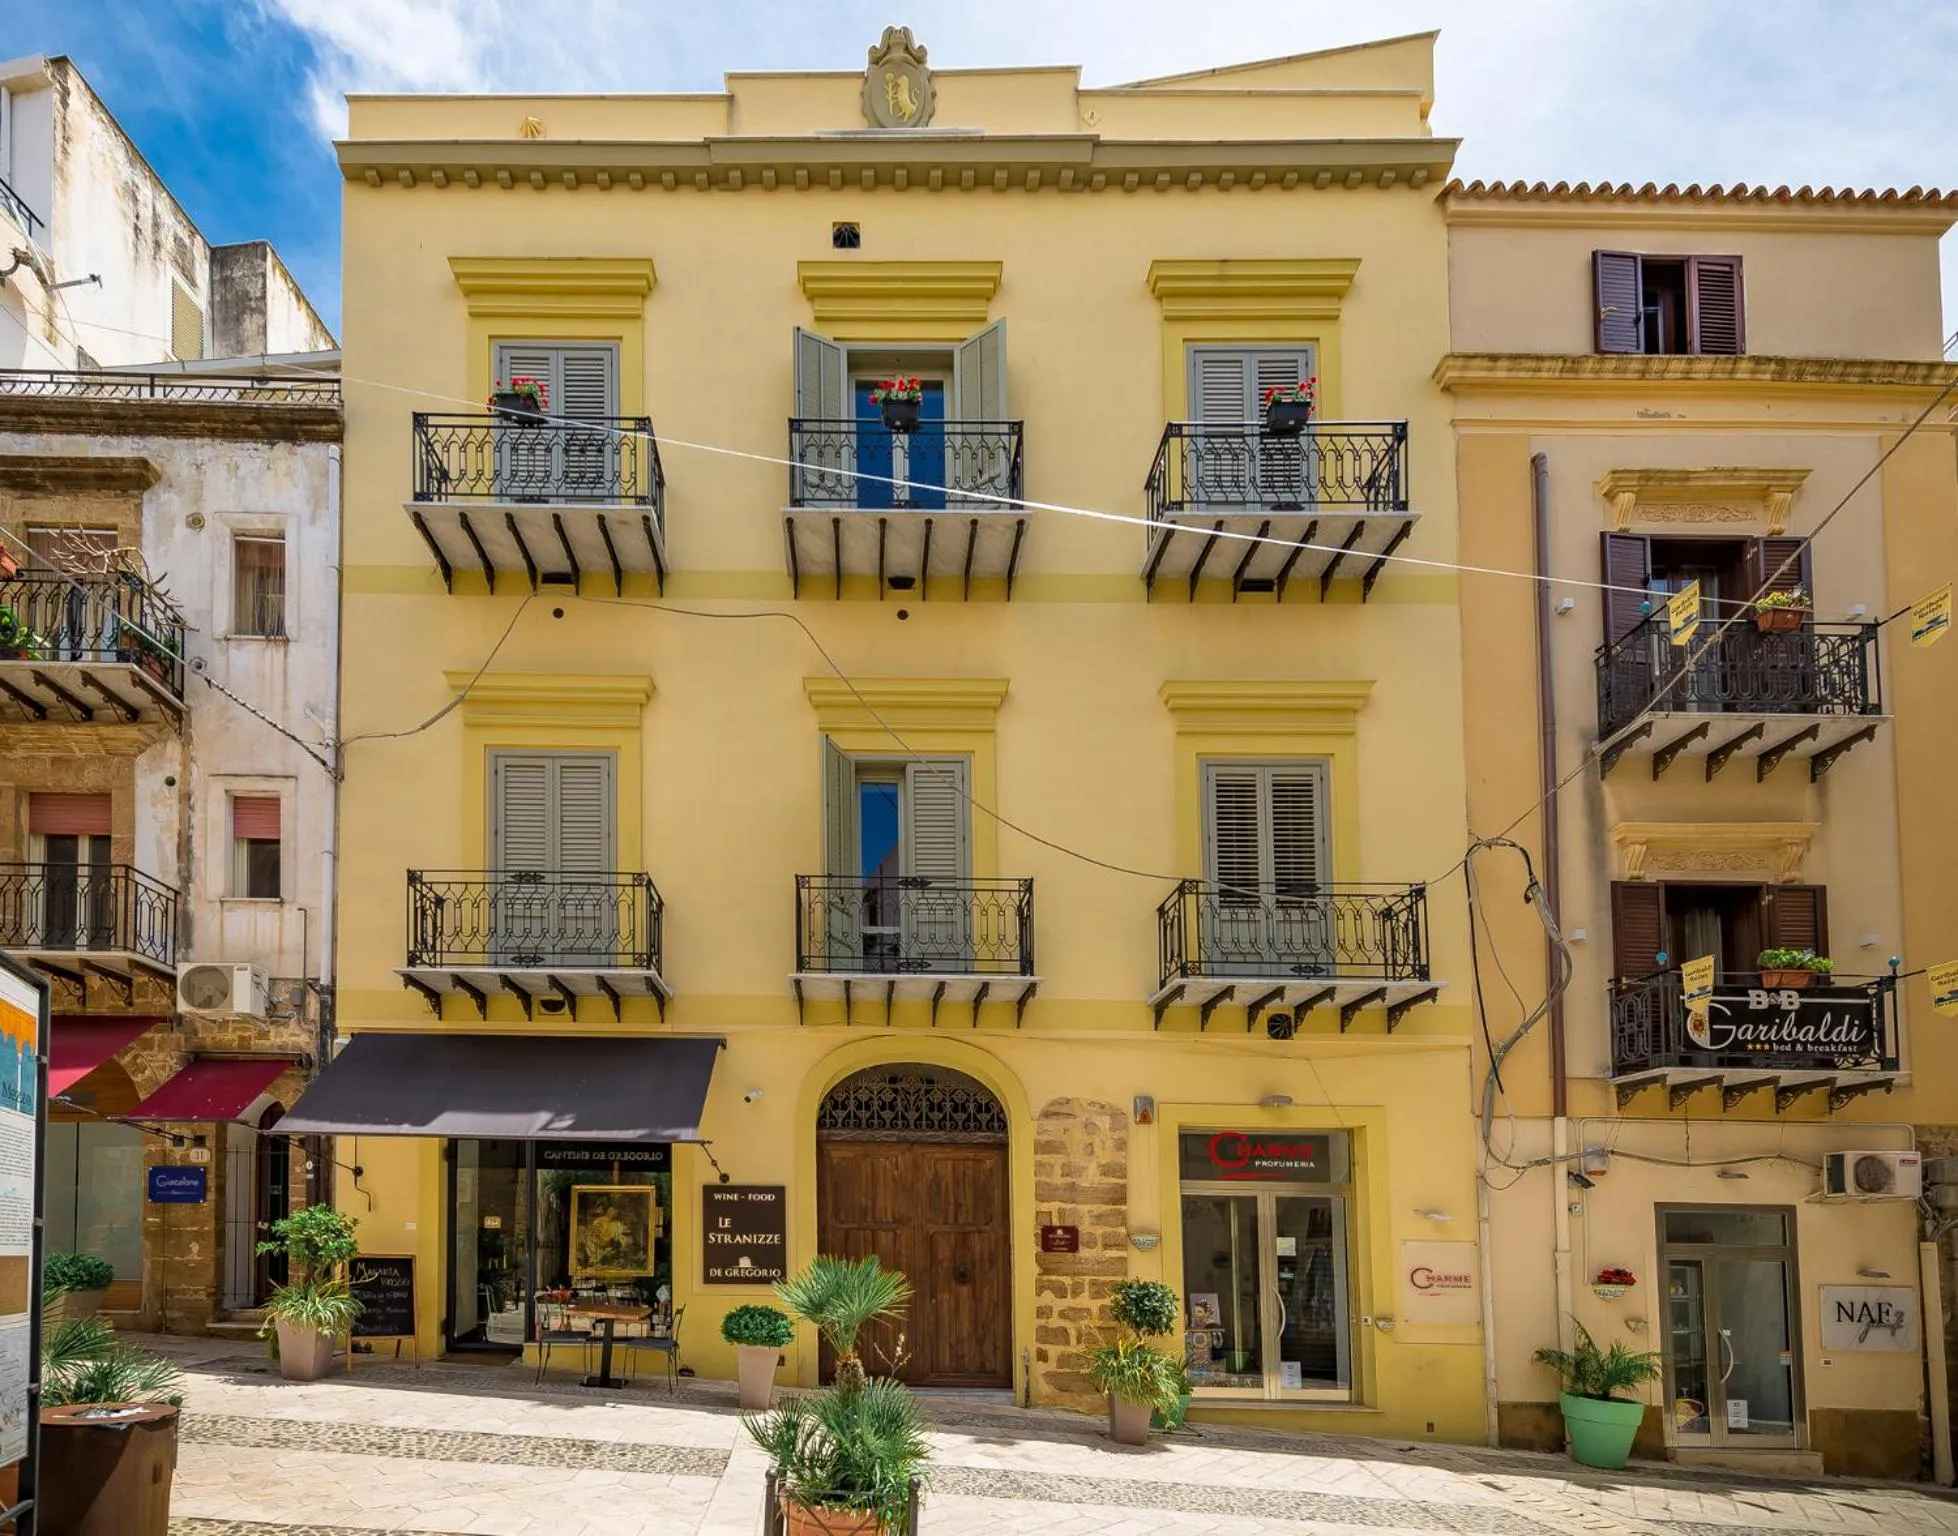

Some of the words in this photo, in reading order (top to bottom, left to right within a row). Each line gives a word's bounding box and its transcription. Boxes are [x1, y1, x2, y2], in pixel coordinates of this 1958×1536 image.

[1748, 989, 1801, 1010] B&B
[1687, 1003, 1867, 1049] Garibaldi
[1773, 1043, 1792, 1052] bed
[1796, 1043, 1804, 1052] &
[1808, 1043, 1858, 1052] breakfast
[1208, 1131, 1314, 1168] CHARME
[592, 1151, 606, 1160] DE
[608, 1151, 663, 1161] GREGORIO
[714, 1193, 738, 1201] WINE
[748, 1193, 776, 1201] FOOD
[718, 1217, 732, 1228] LE
[708, 1232, 781, 1244] STRANIZZE
[709, 1268, 722, 1277] DE
[725, 1268, 782, 1277] GREGORIO
[1410, 1267, 1471, 1290] CHARME
